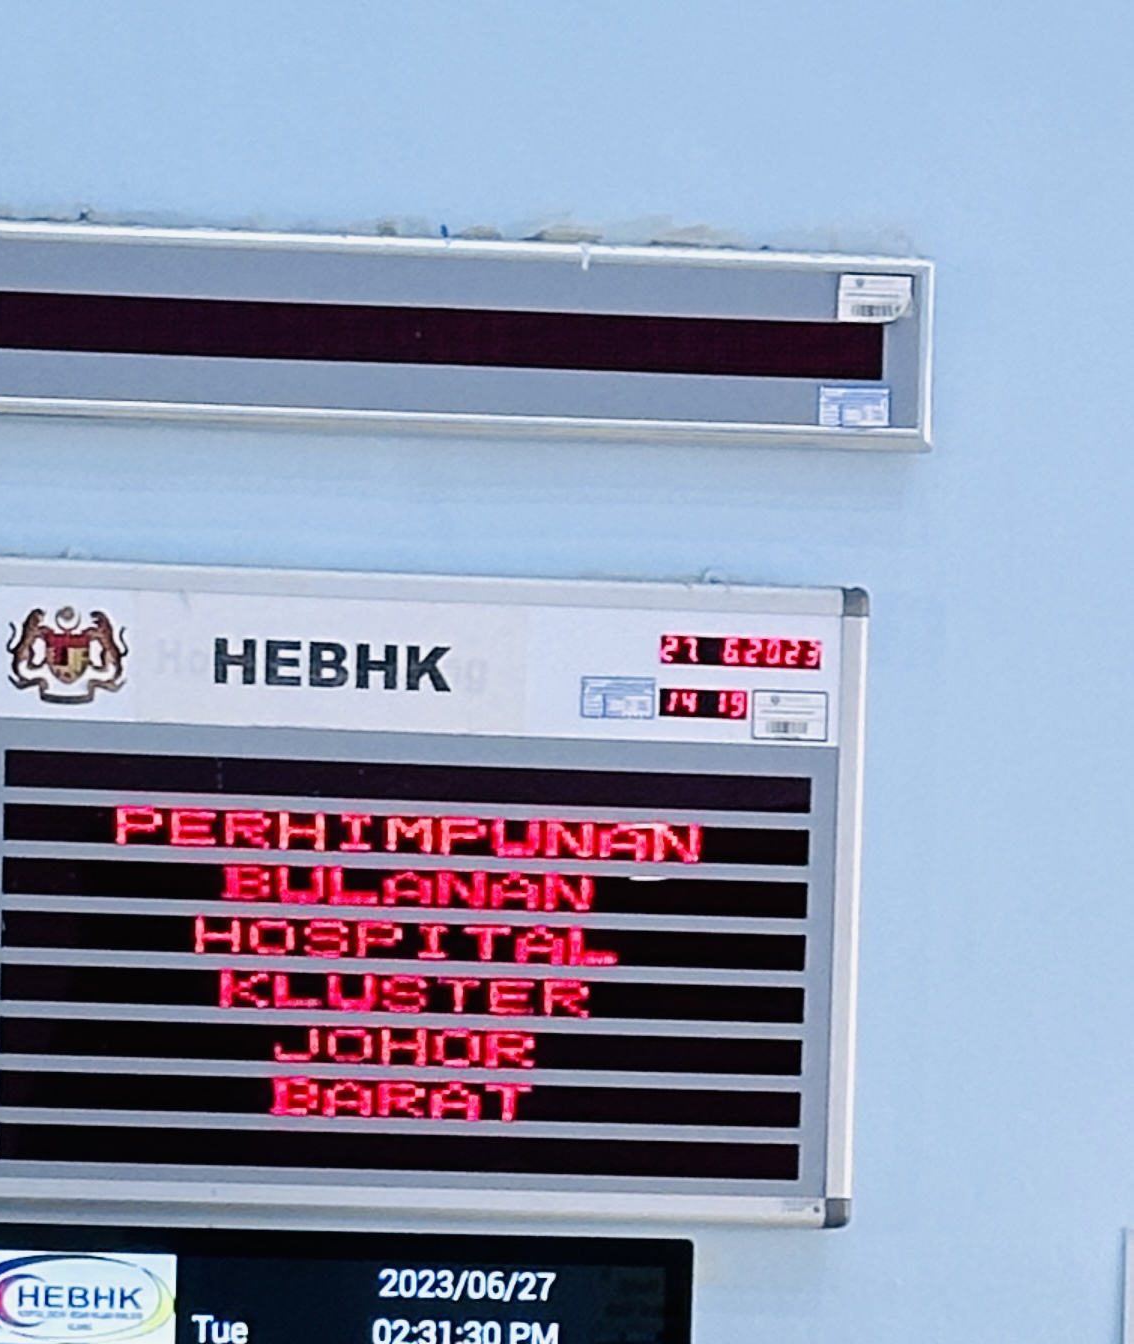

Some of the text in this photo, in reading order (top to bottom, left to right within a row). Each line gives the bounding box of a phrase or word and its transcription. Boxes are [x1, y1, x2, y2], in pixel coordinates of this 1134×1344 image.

[214, 637, 452, 692] HEBHK
[115, 807, 700, 863] PERHIMPUNAN
[222, 864, 593, 911] BULANAN
[193, 915, 617, 965] HOSPITAL
[219, 969, 590, 1018] KLUSTER
[274, 1027, 536, 1068] JOHOR
[270, 1076, 532, 1122] BARAT
[18, 1285, 143, 1310] HEBHK
[378, 1269, 557, 1302] 2023/06/27
[191, 1315, 249, 1344] Tue
